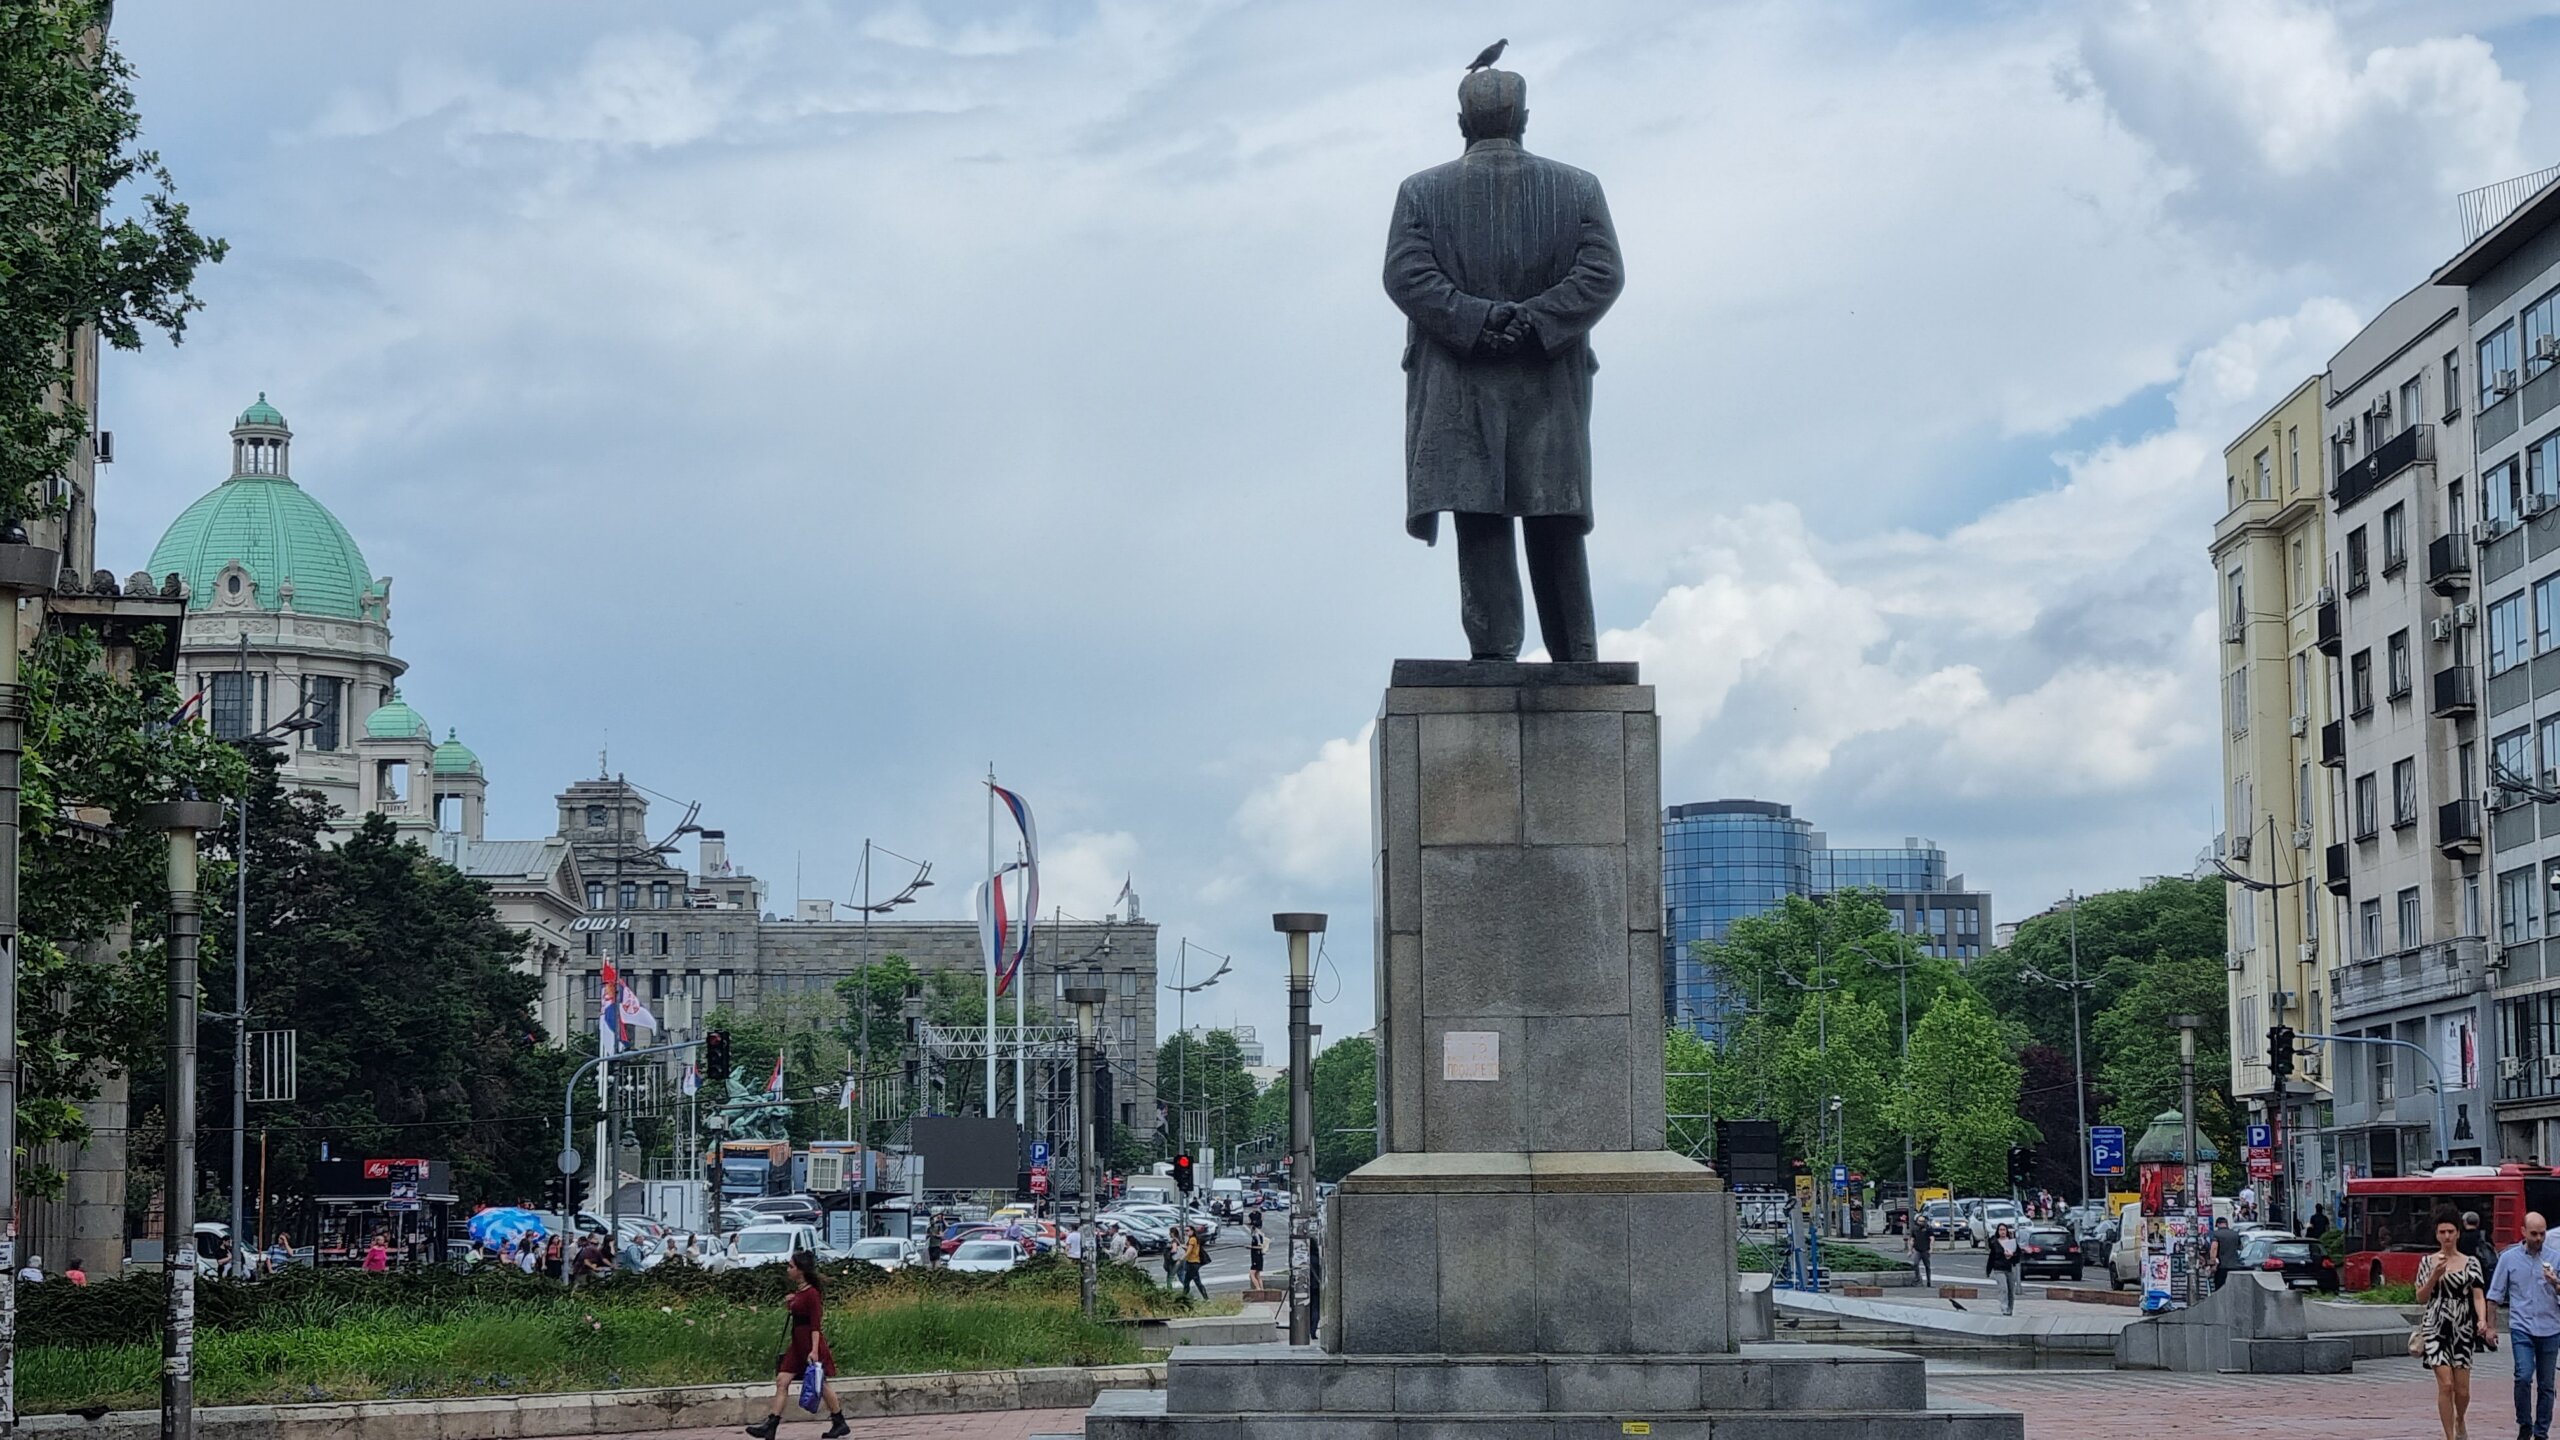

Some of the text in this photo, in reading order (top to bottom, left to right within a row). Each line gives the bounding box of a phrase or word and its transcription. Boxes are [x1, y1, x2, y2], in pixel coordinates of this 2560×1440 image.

[2252, 1127, 2266, 1146] P
[1034, 1144, 1046, 1159] P
[2096, 1149, 2109, 1165] P
